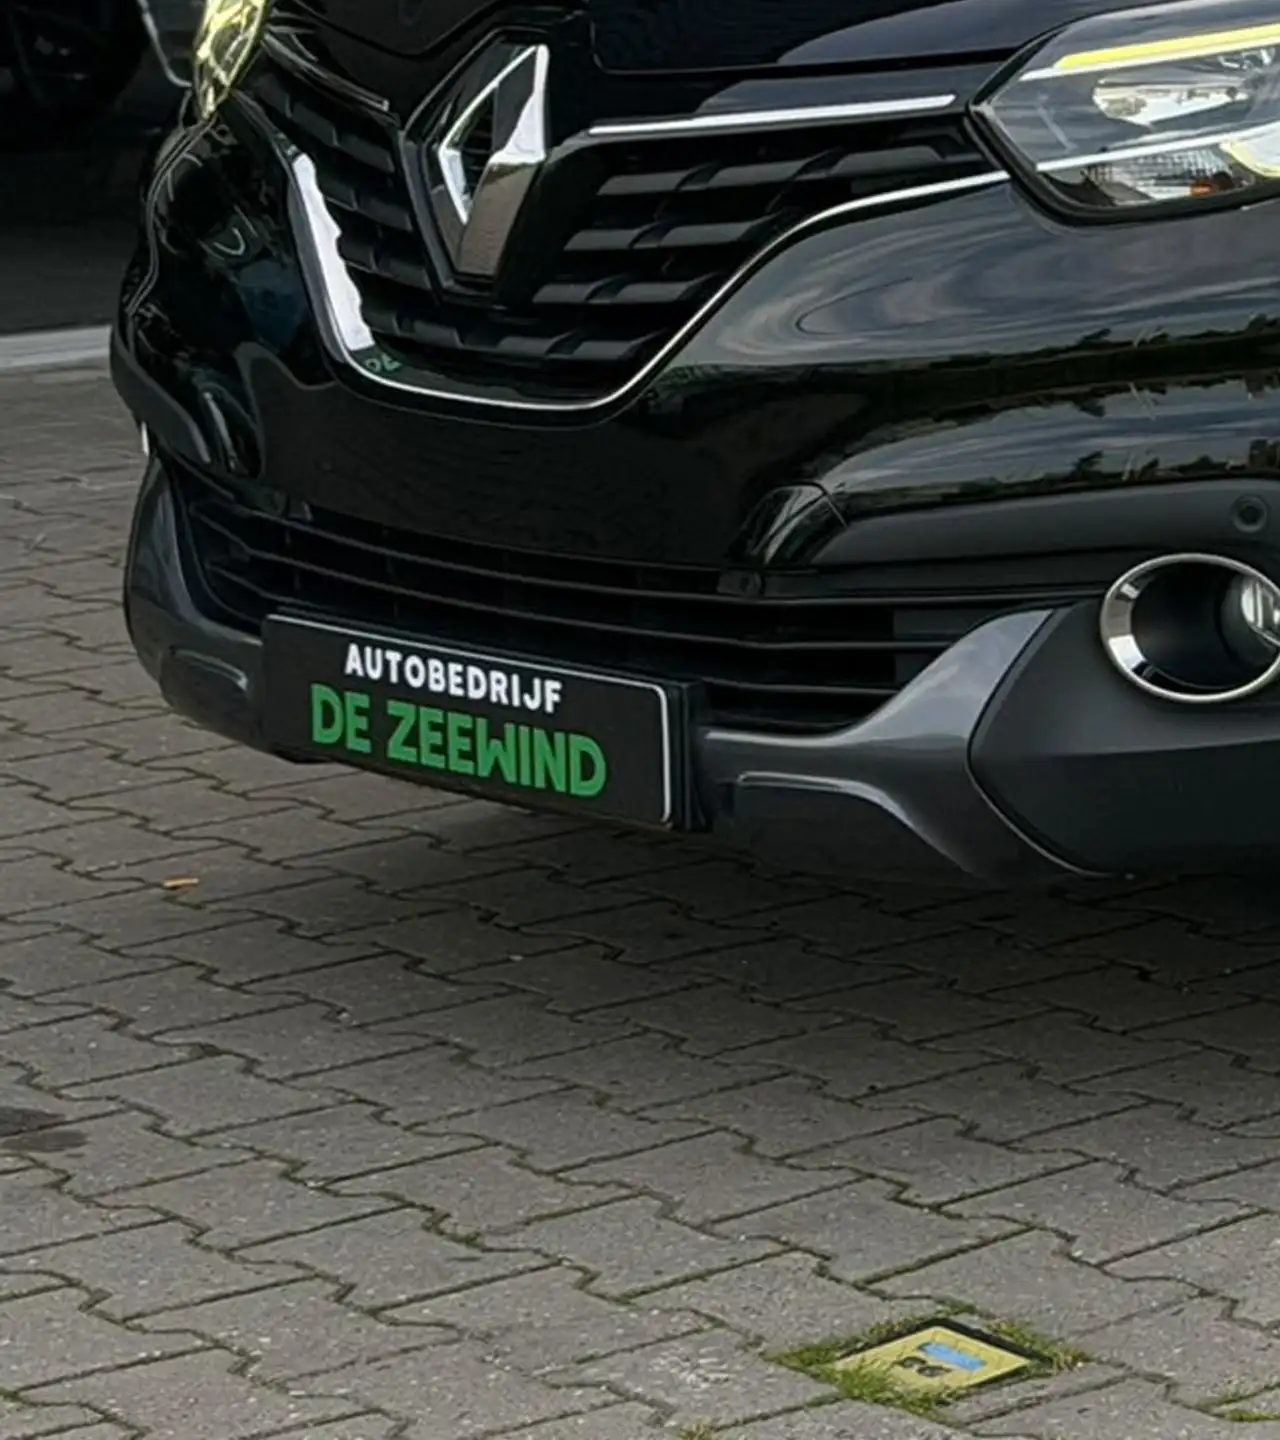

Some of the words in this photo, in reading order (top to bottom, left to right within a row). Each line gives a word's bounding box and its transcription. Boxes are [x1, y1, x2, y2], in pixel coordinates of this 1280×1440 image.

[345, 643, 562, 713] AUTOBEDRIJF
[311, 683, 371, 753] DE
[387, 699, 606, 796] ZEEWIND
